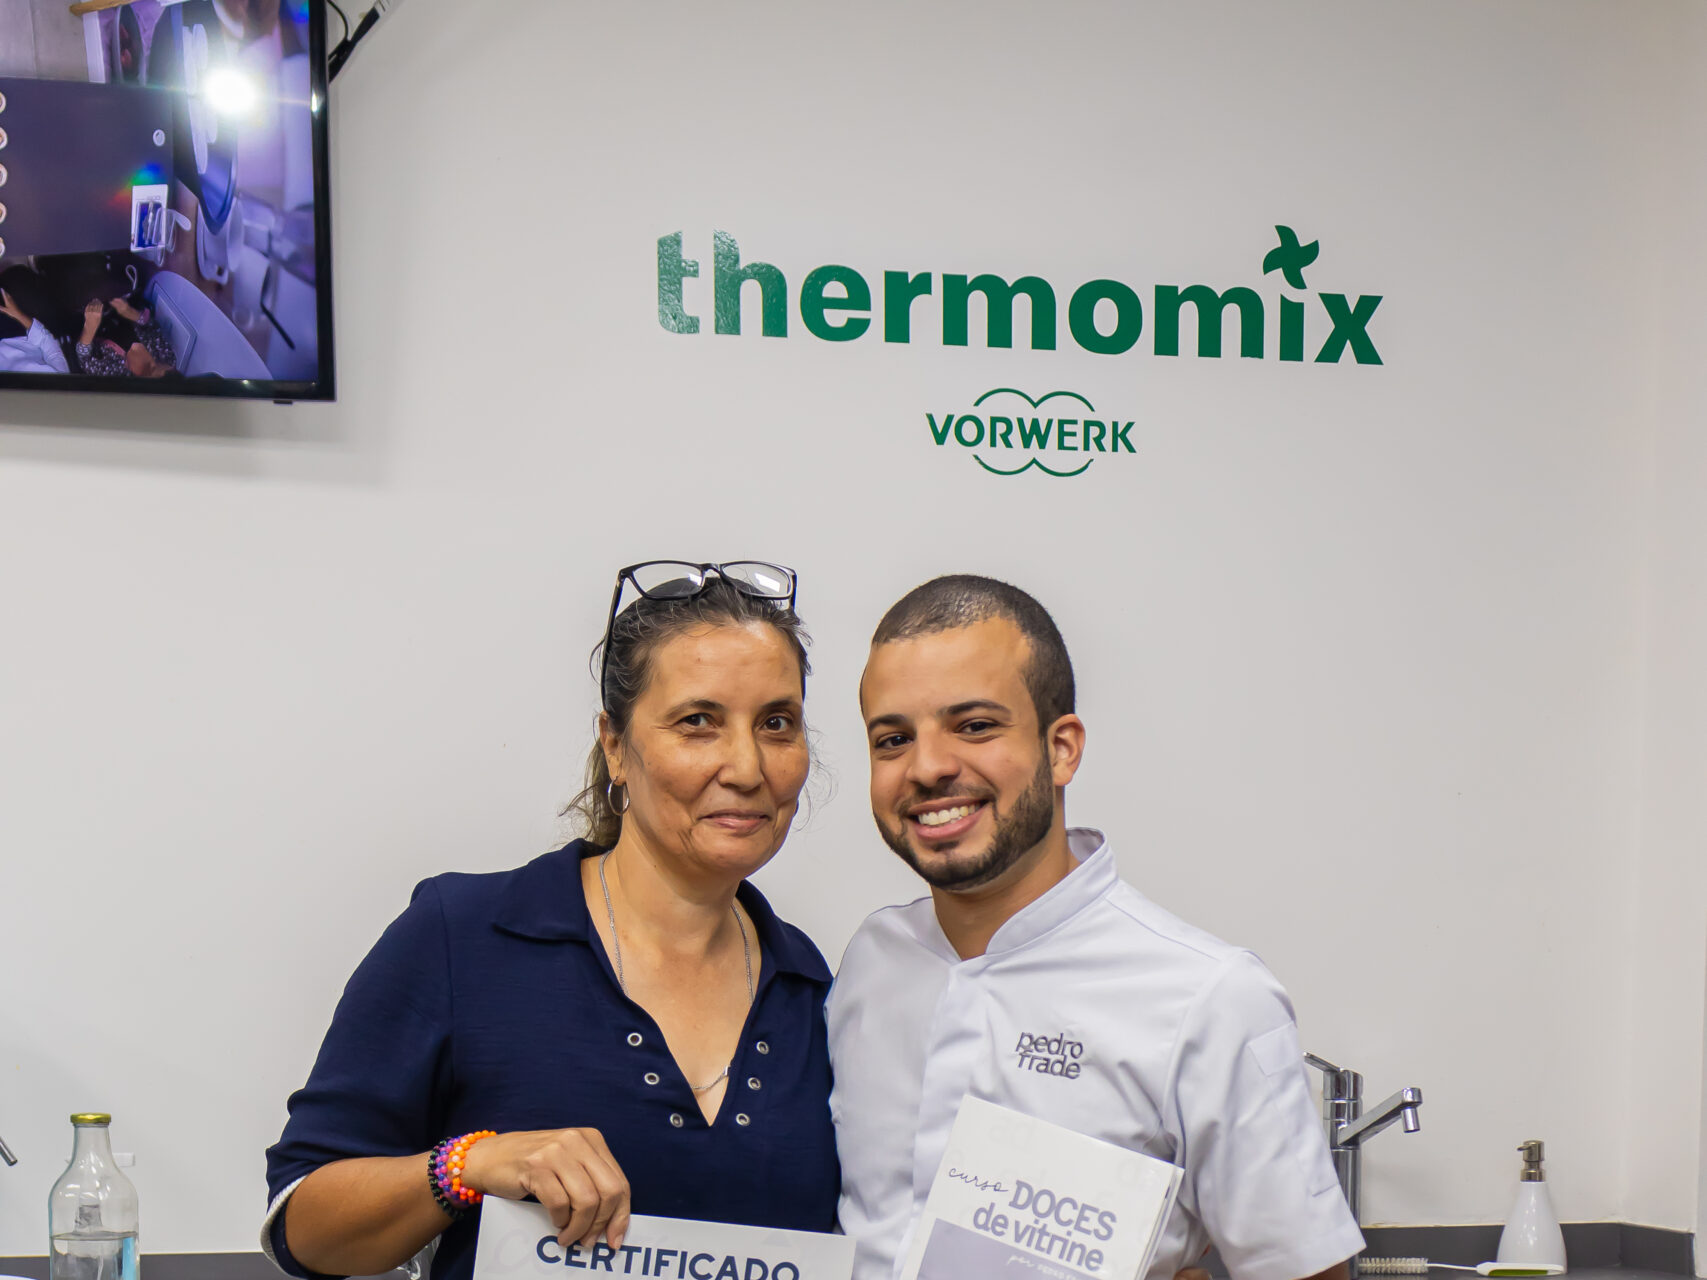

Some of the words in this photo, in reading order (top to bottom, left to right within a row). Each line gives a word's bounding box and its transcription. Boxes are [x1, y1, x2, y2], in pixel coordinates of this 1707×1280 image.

[656, 225, 1384, 365] thermomix
[925, 411, 1137, 453] VORWERK
[1015, 1031, 1084, 1059] pedro
[1018, 1049, 1081, 1080] frade
[948, 1168, 1008, 1192] curso
[1008, 1179, 1117, 1241] DOCES
[973, 1202, 1009, 1237] de
[1014, 1218, 1104, 1272] vitrine
